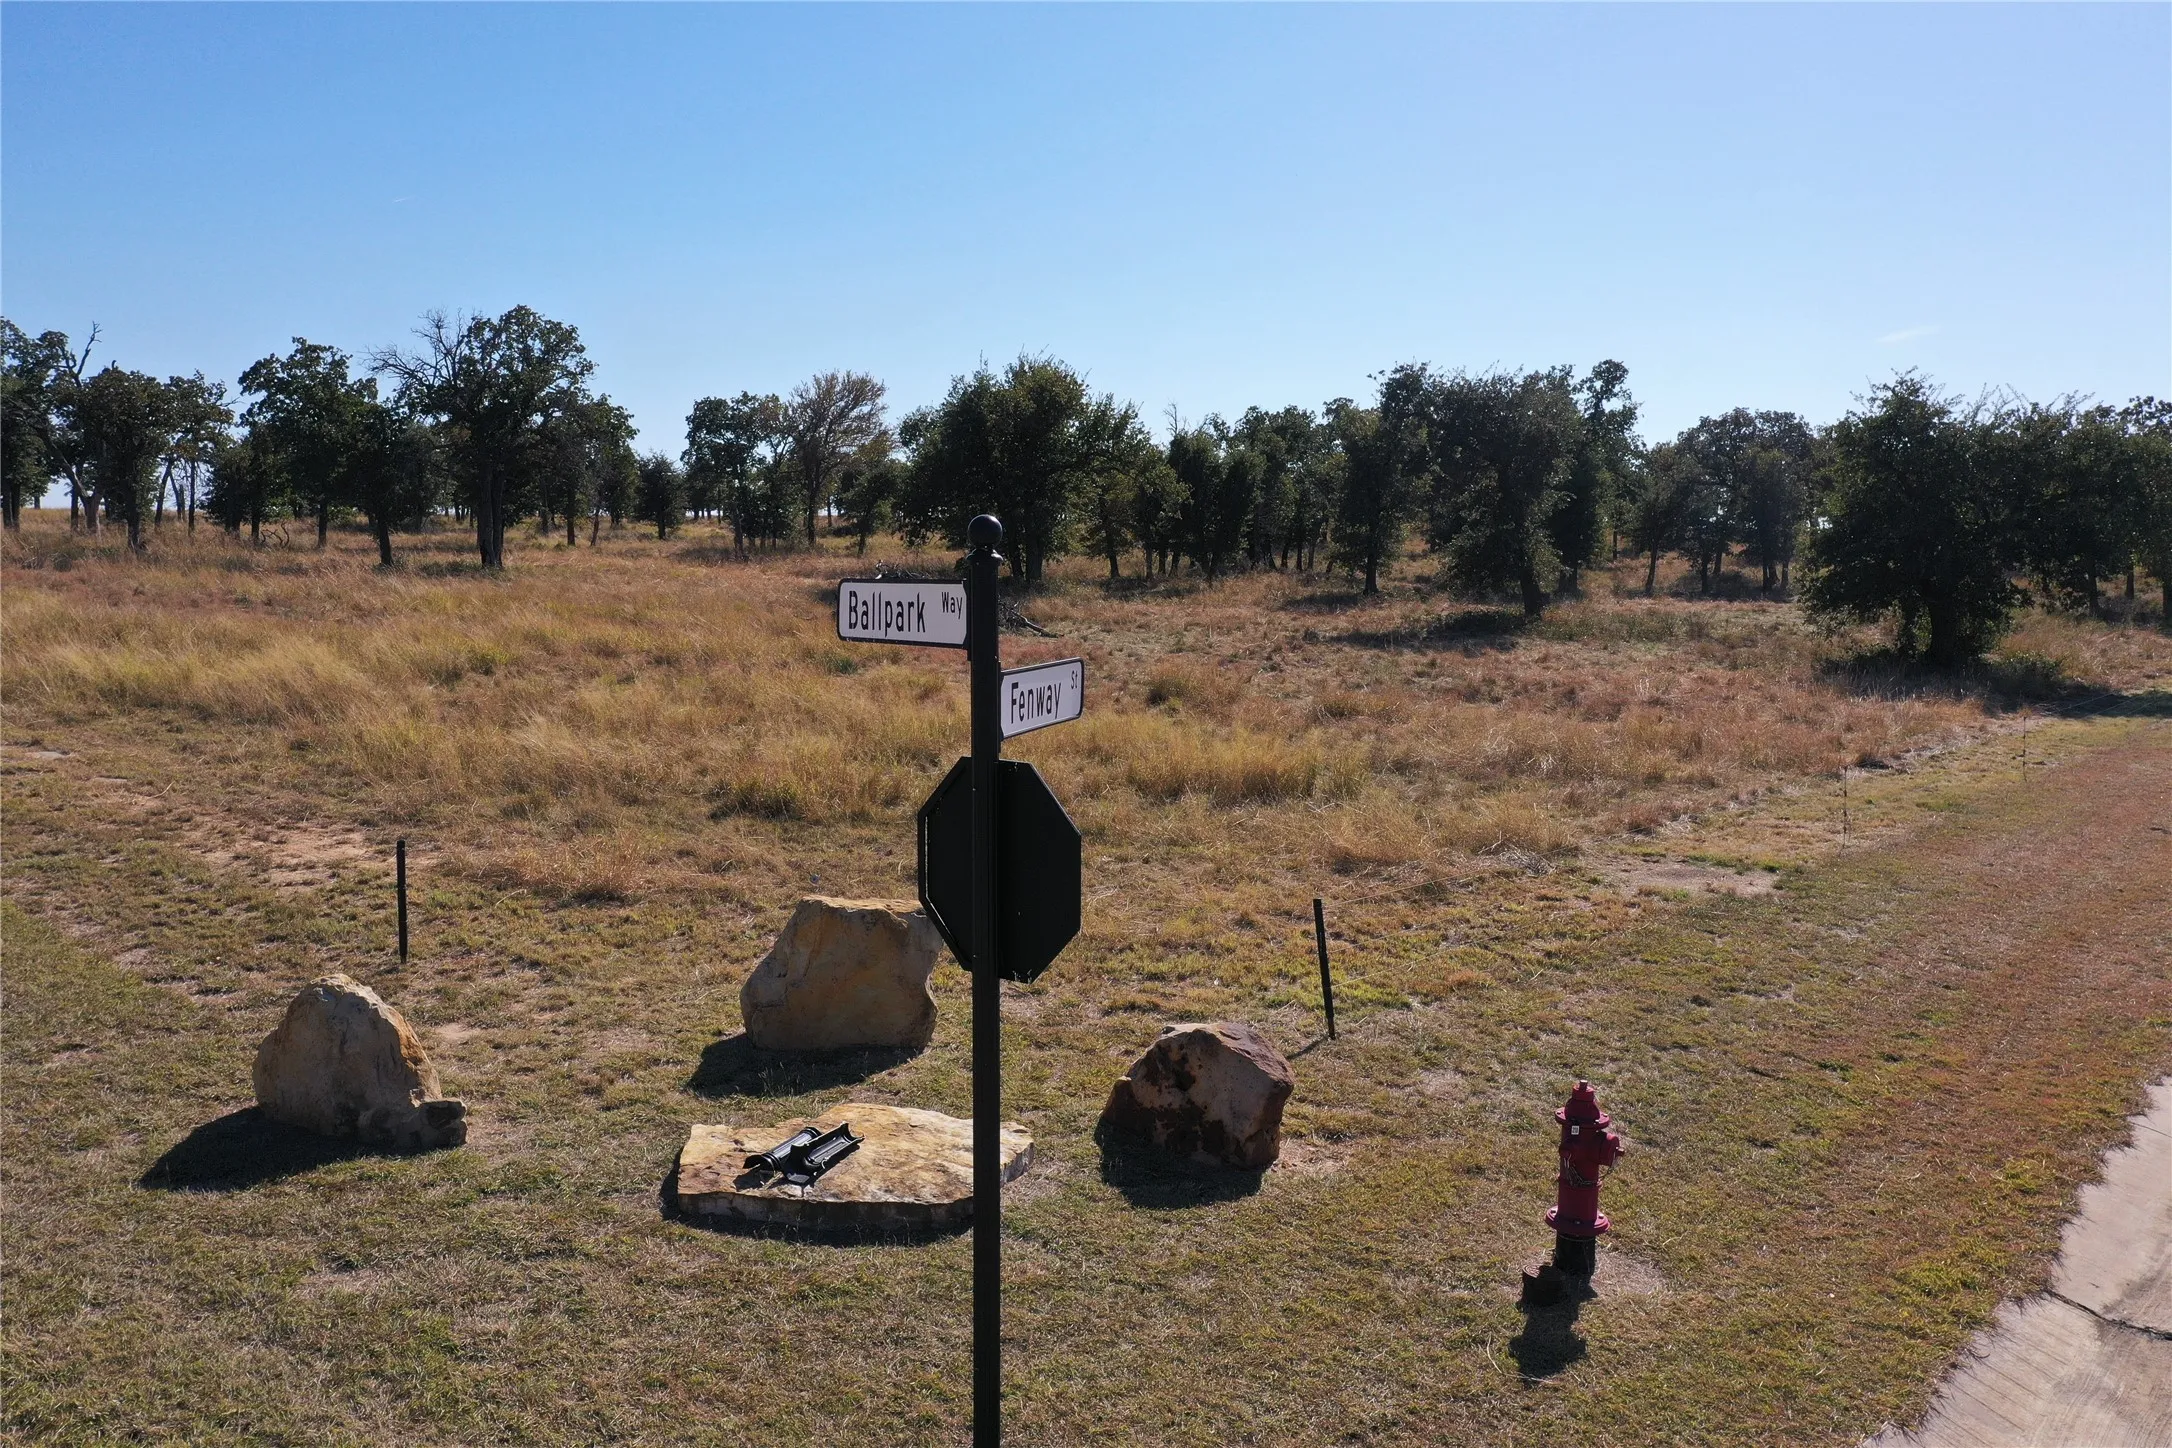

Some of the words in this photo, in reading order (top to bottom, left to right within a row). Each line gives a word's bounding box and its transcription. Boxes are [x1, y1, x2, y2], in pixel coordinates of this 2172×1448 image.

[848, 590, 926, 638] Ballpark
[941, 591, 963, 620] Way
[1011, 682, 1062, 724] Fenway
[1070, 670, 1078, 690] St
